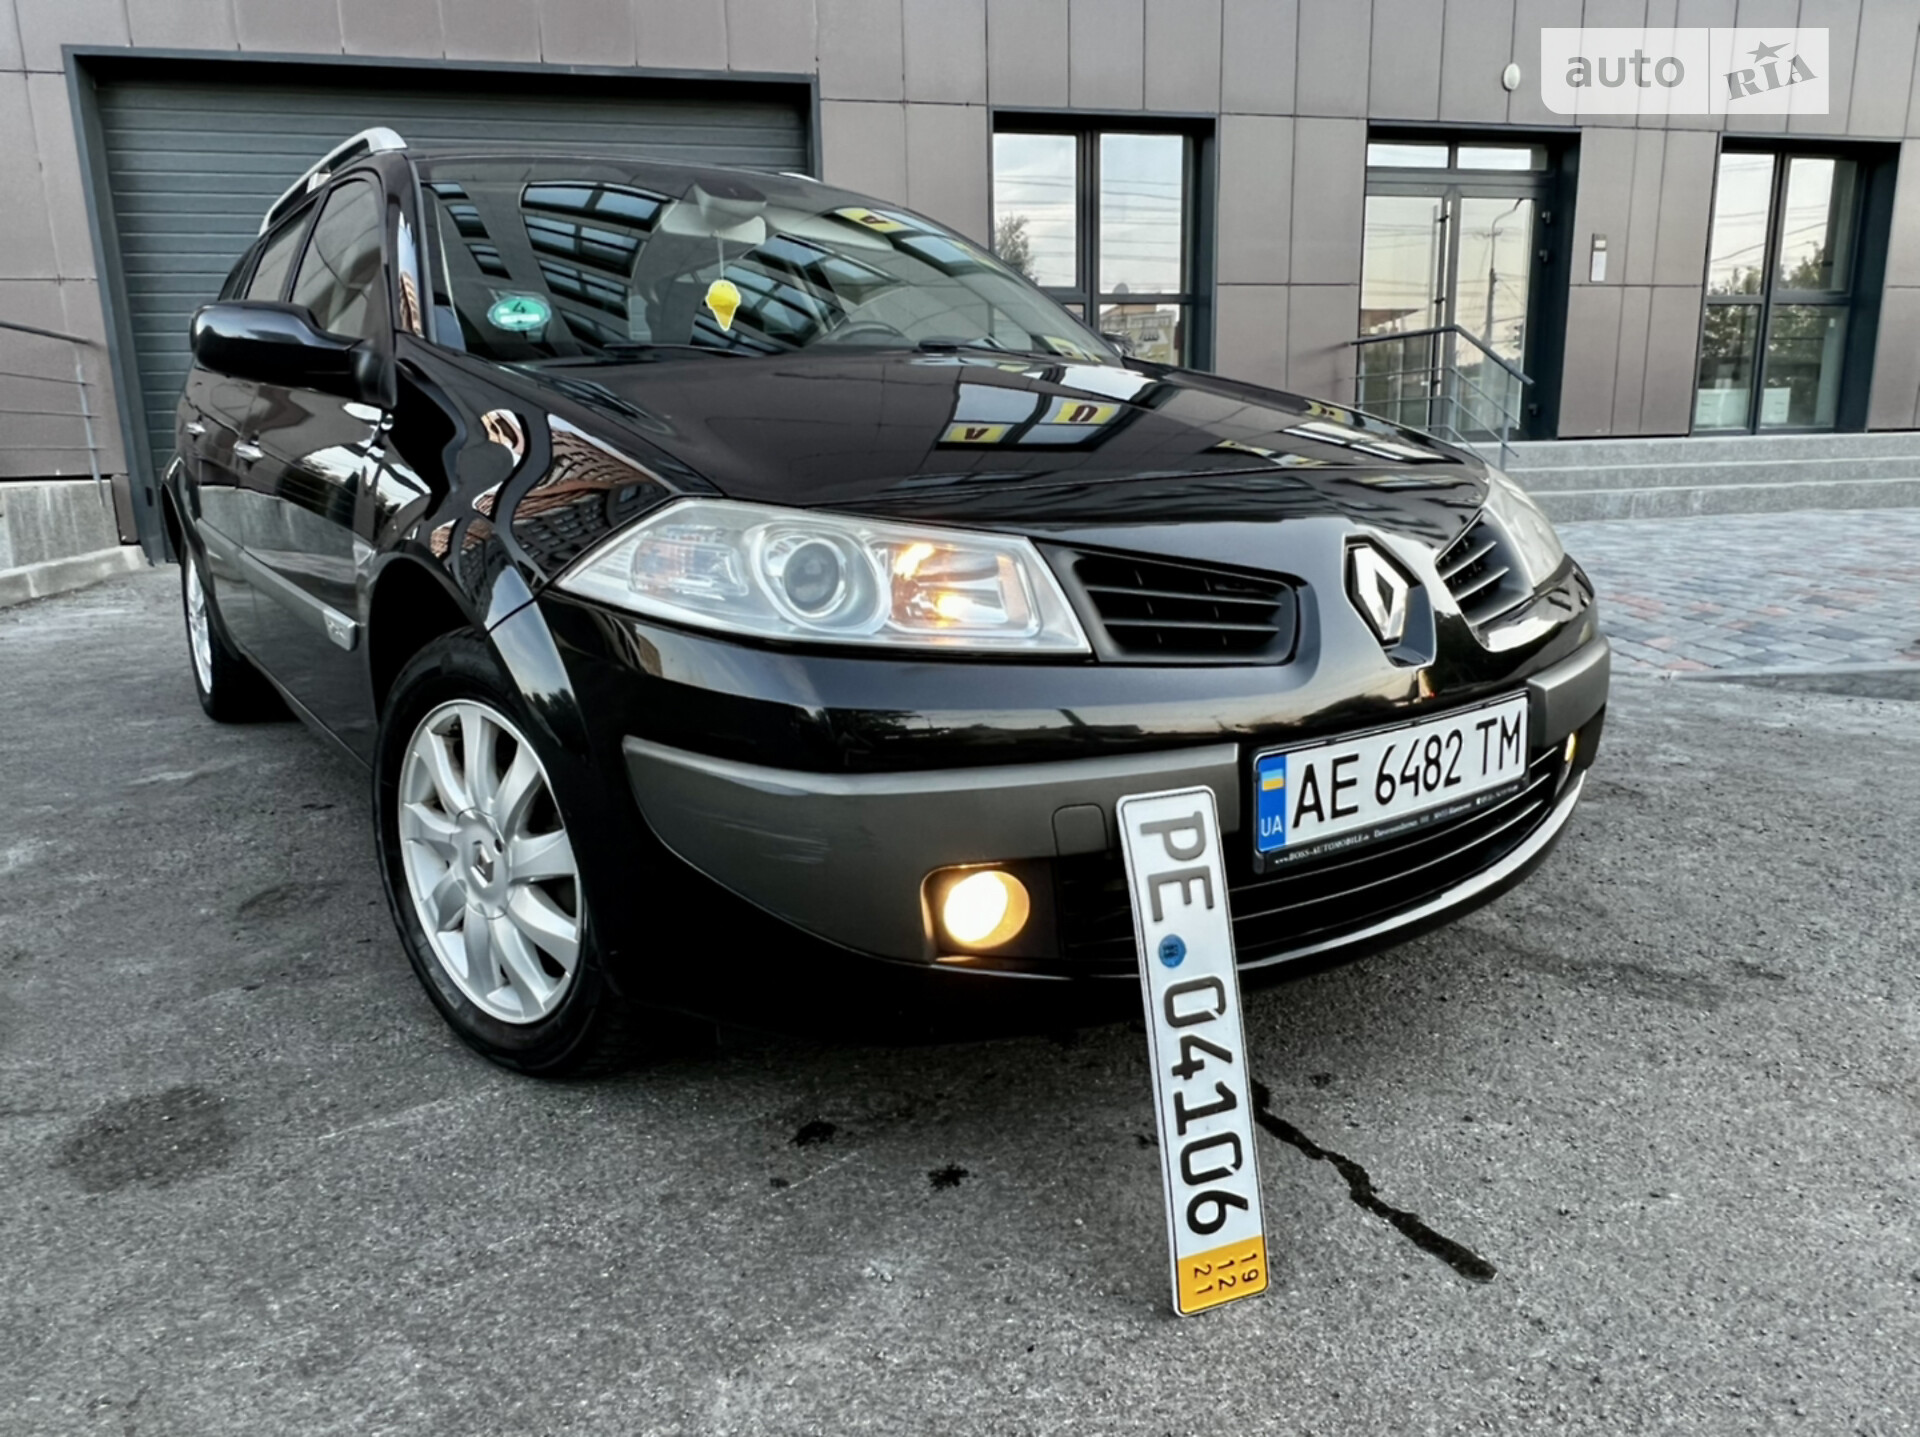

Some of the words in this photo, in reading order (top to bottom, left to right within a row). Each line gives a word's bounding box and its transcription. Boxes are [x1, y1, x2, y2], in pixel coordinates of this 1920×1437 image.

[1261, 815, 1284, 837] UA
[1292, 753, 1359, 829] AE
[1375, 728, 1463, 806] 6482
[1476, 711, 1522, 776] TM
[1139, 810, 1215, 923] PE
[1164, 975, 1250, 1236] 04106
